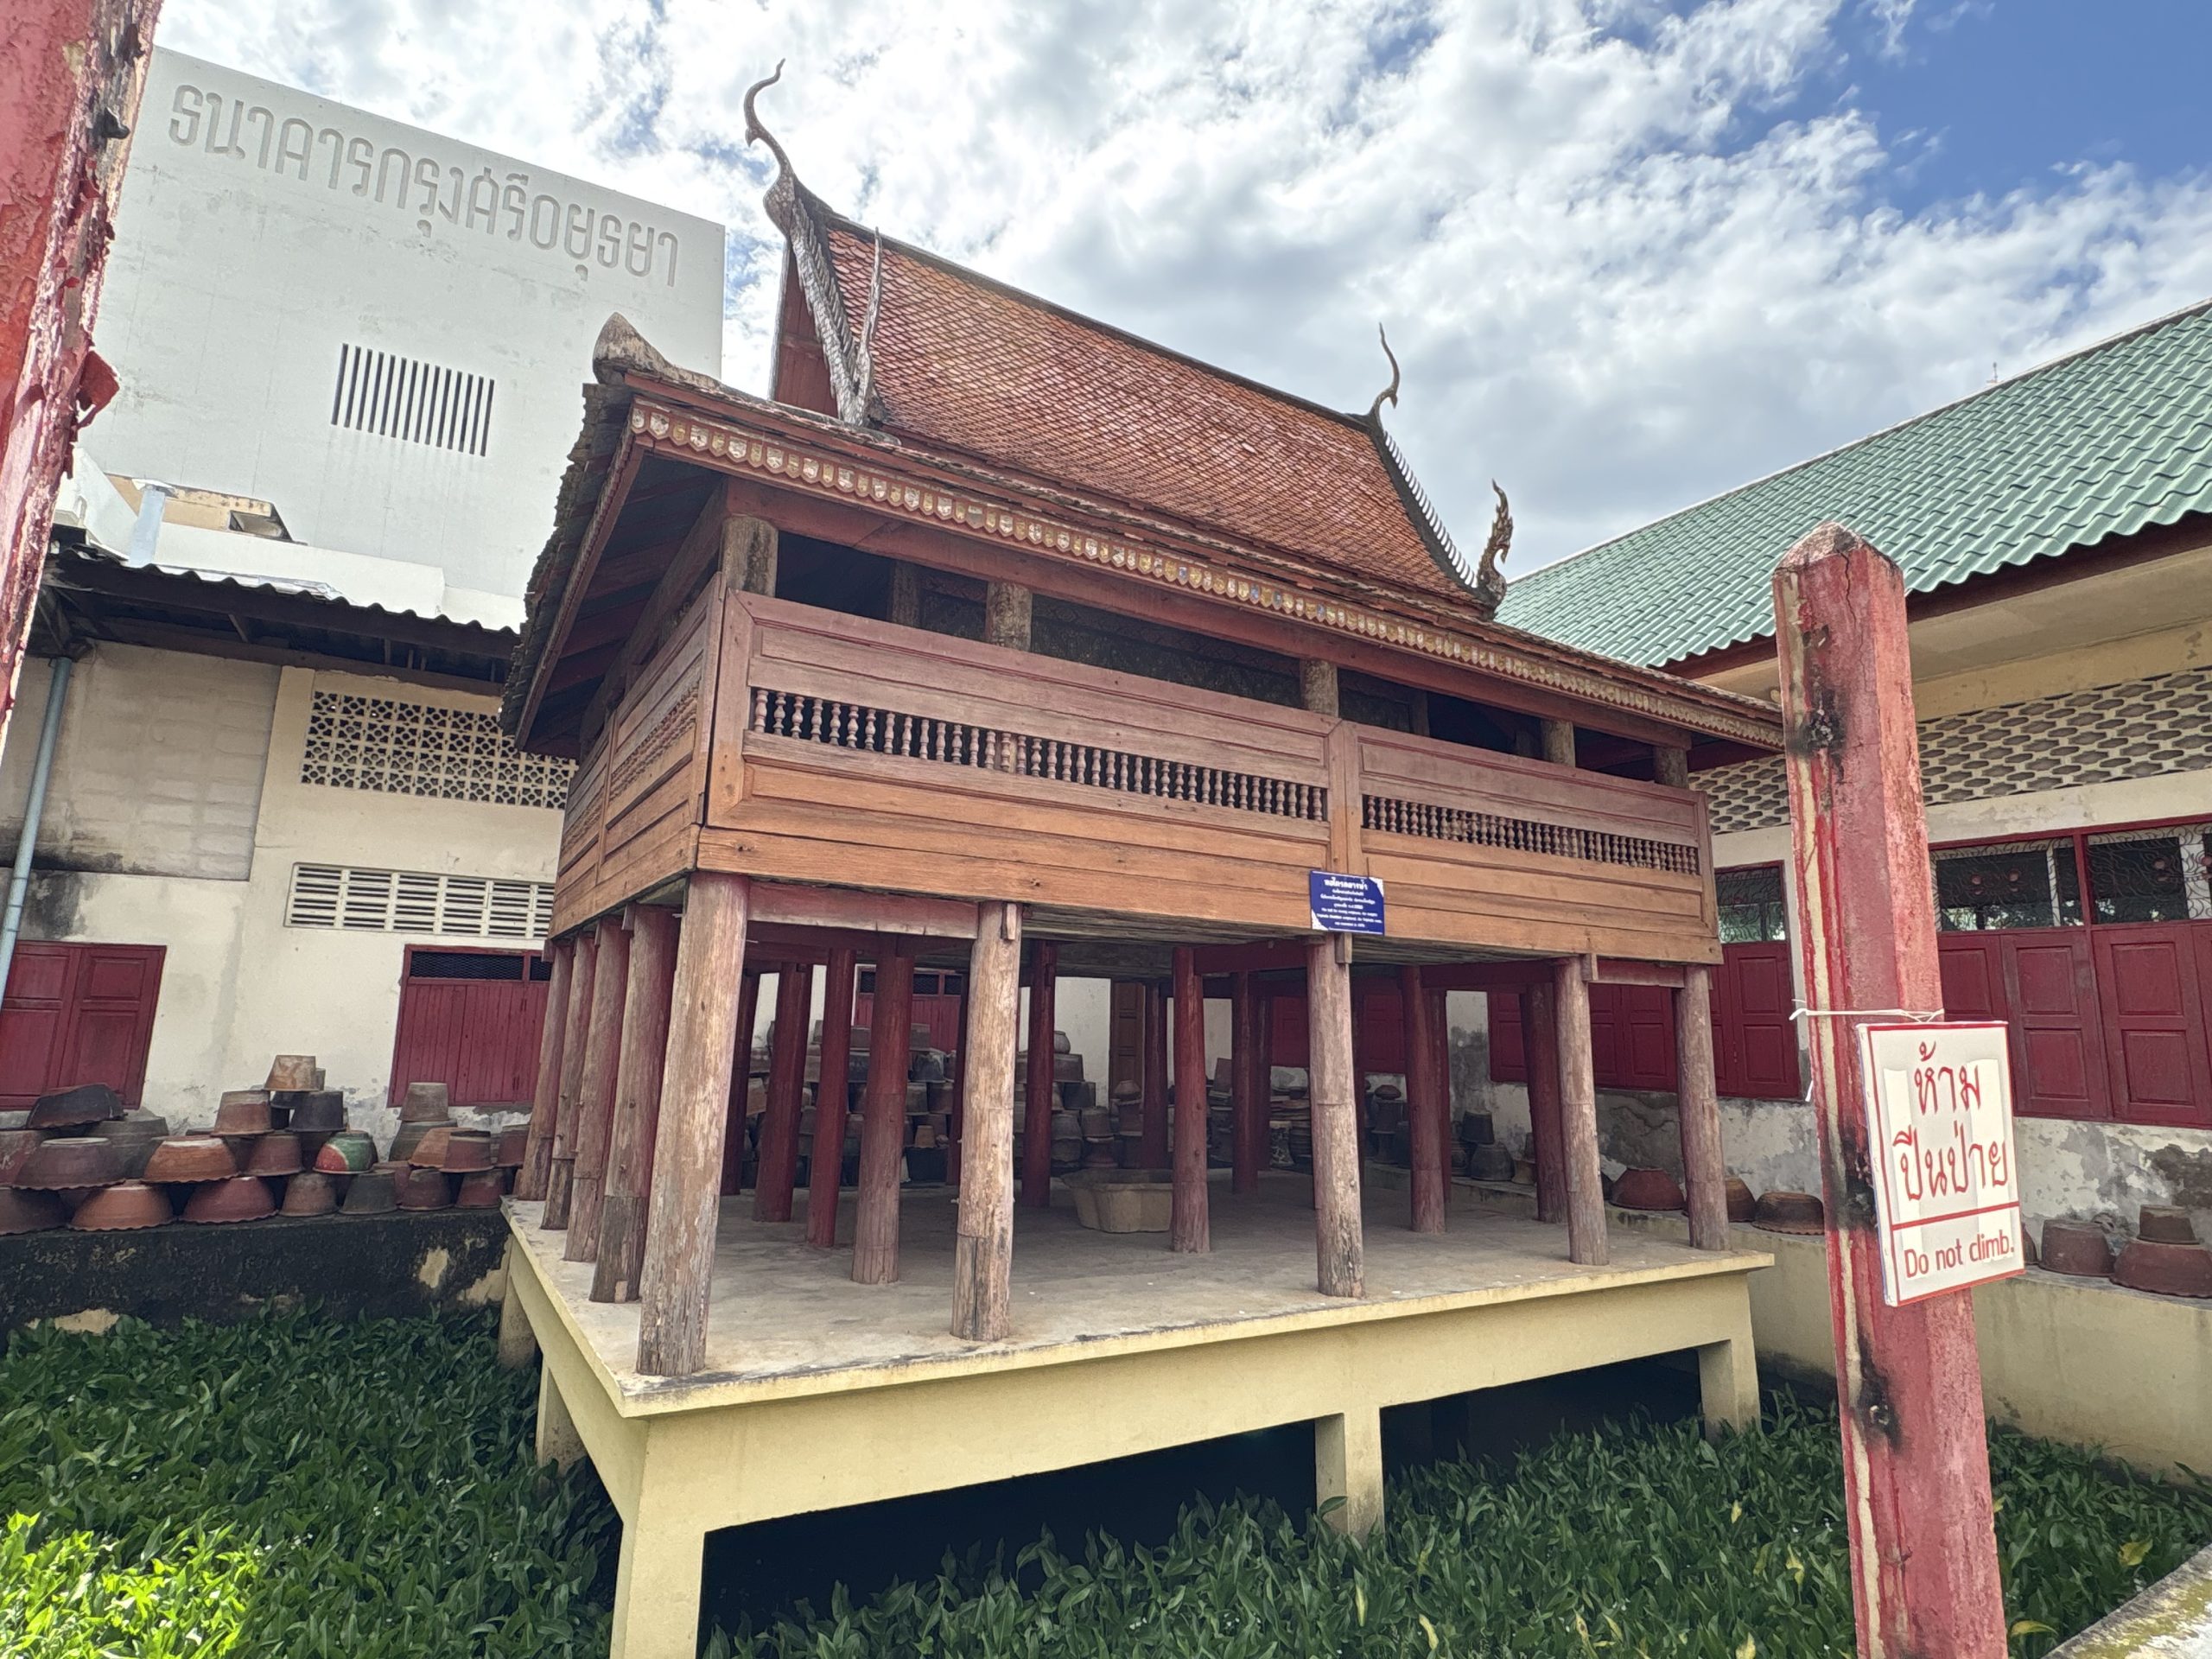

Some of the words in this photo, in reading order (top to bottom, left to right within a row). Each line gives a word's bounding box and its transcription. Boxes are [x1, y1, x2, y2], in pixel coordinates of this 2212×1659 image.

[168, 84, 679, 287] ธนาคารกรุงศรีอยุธยา
[1914, 1040, 1982, 1116] ห้าม
[1892, 1119, 2009, 1202] ปีนป่าย
[1904, 1249, 1929, 1278] Do
[1936, 1238, 1964, 1271] not
[1969, 1230, 2015, 1262] climb.
